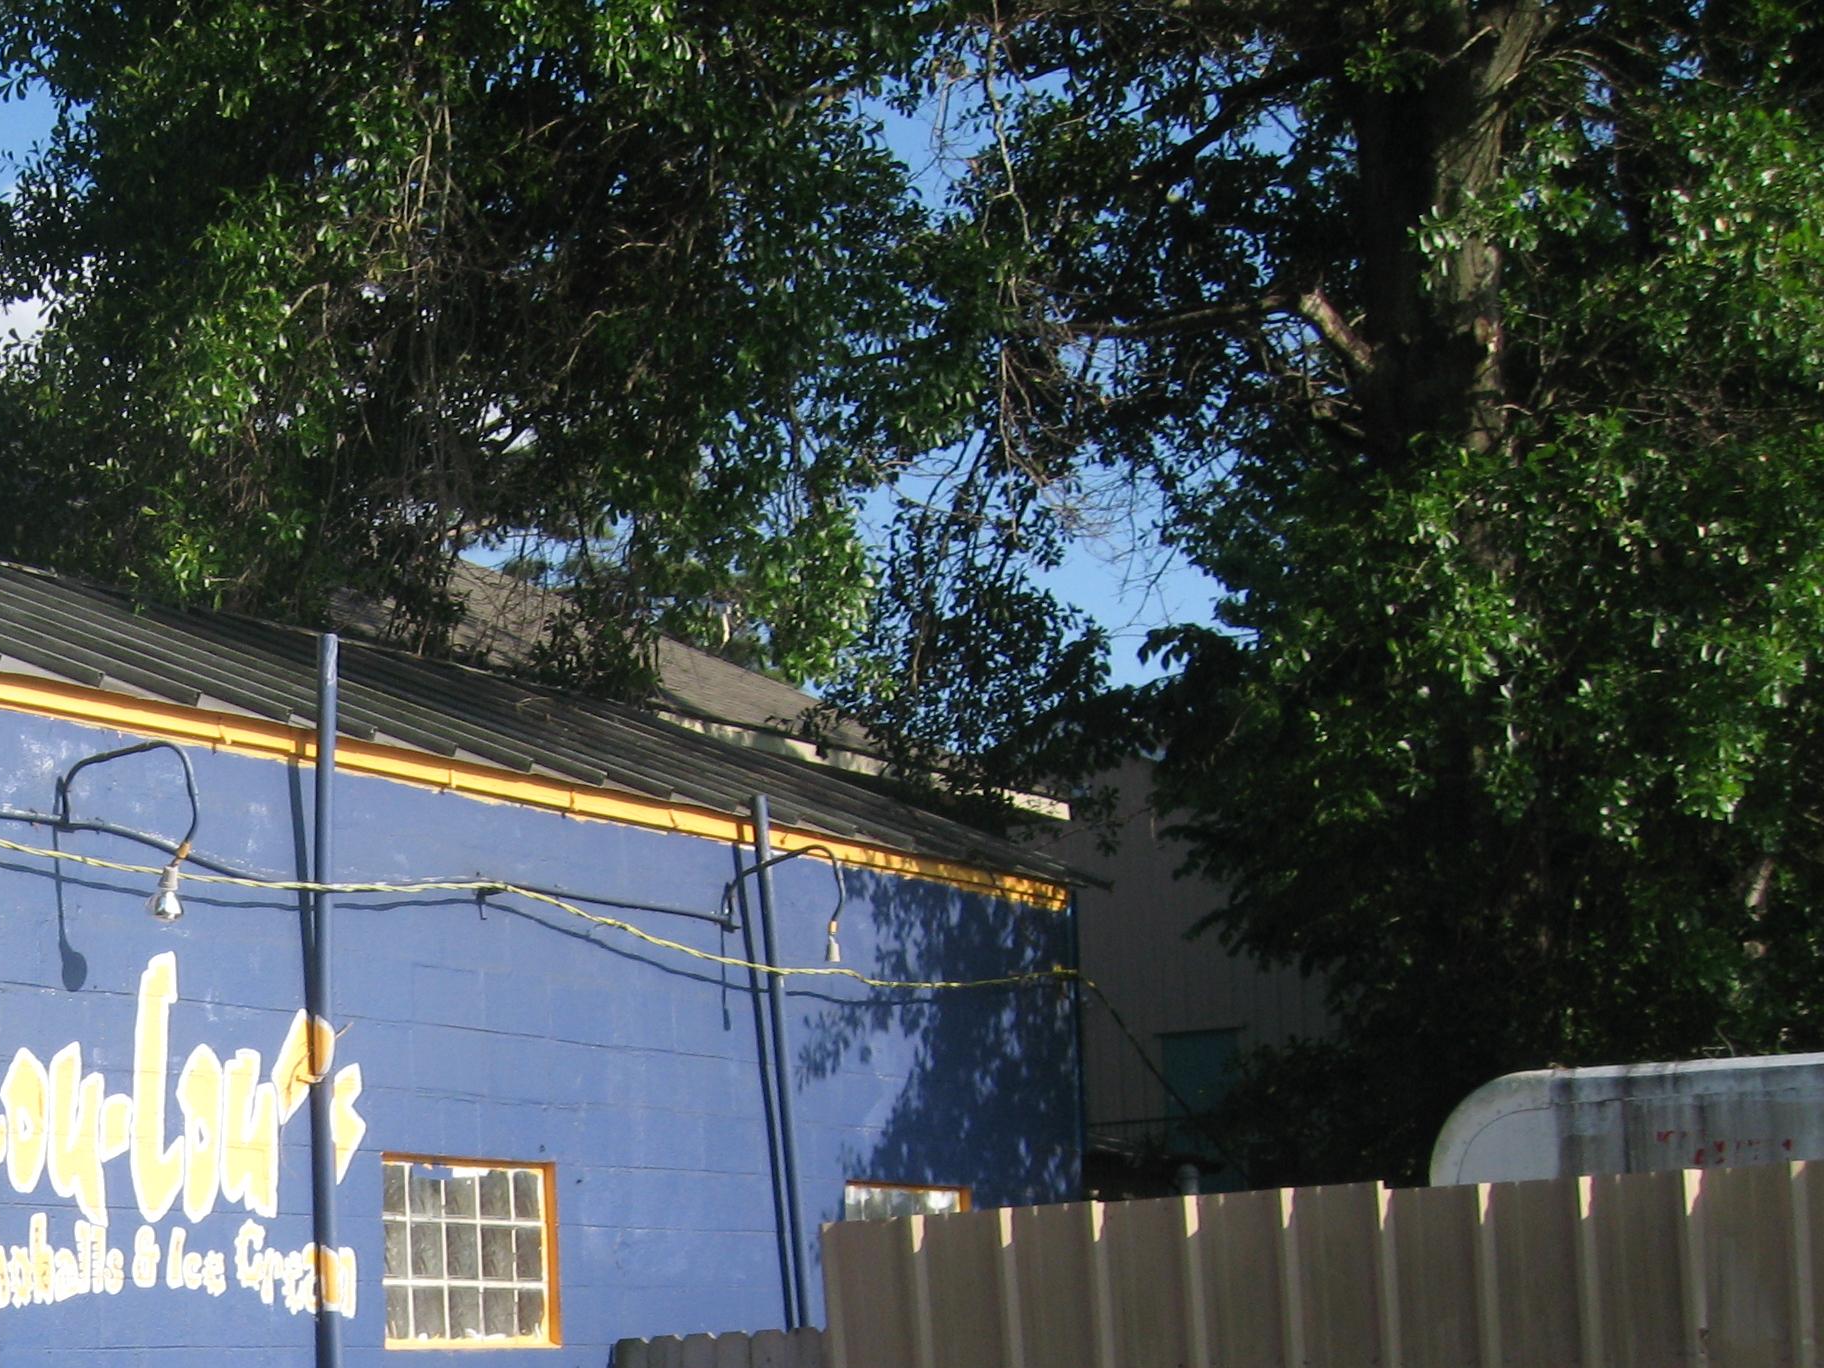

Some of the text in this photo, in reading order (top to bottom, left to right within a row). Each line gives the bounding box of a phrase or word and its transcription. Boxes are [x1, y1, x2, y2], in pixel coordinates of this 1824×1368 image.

[133, 1226, 161, 1288] &
[166, 1226, 227, 1298] Ice
[234, 1218, 358, 1319] Cream
